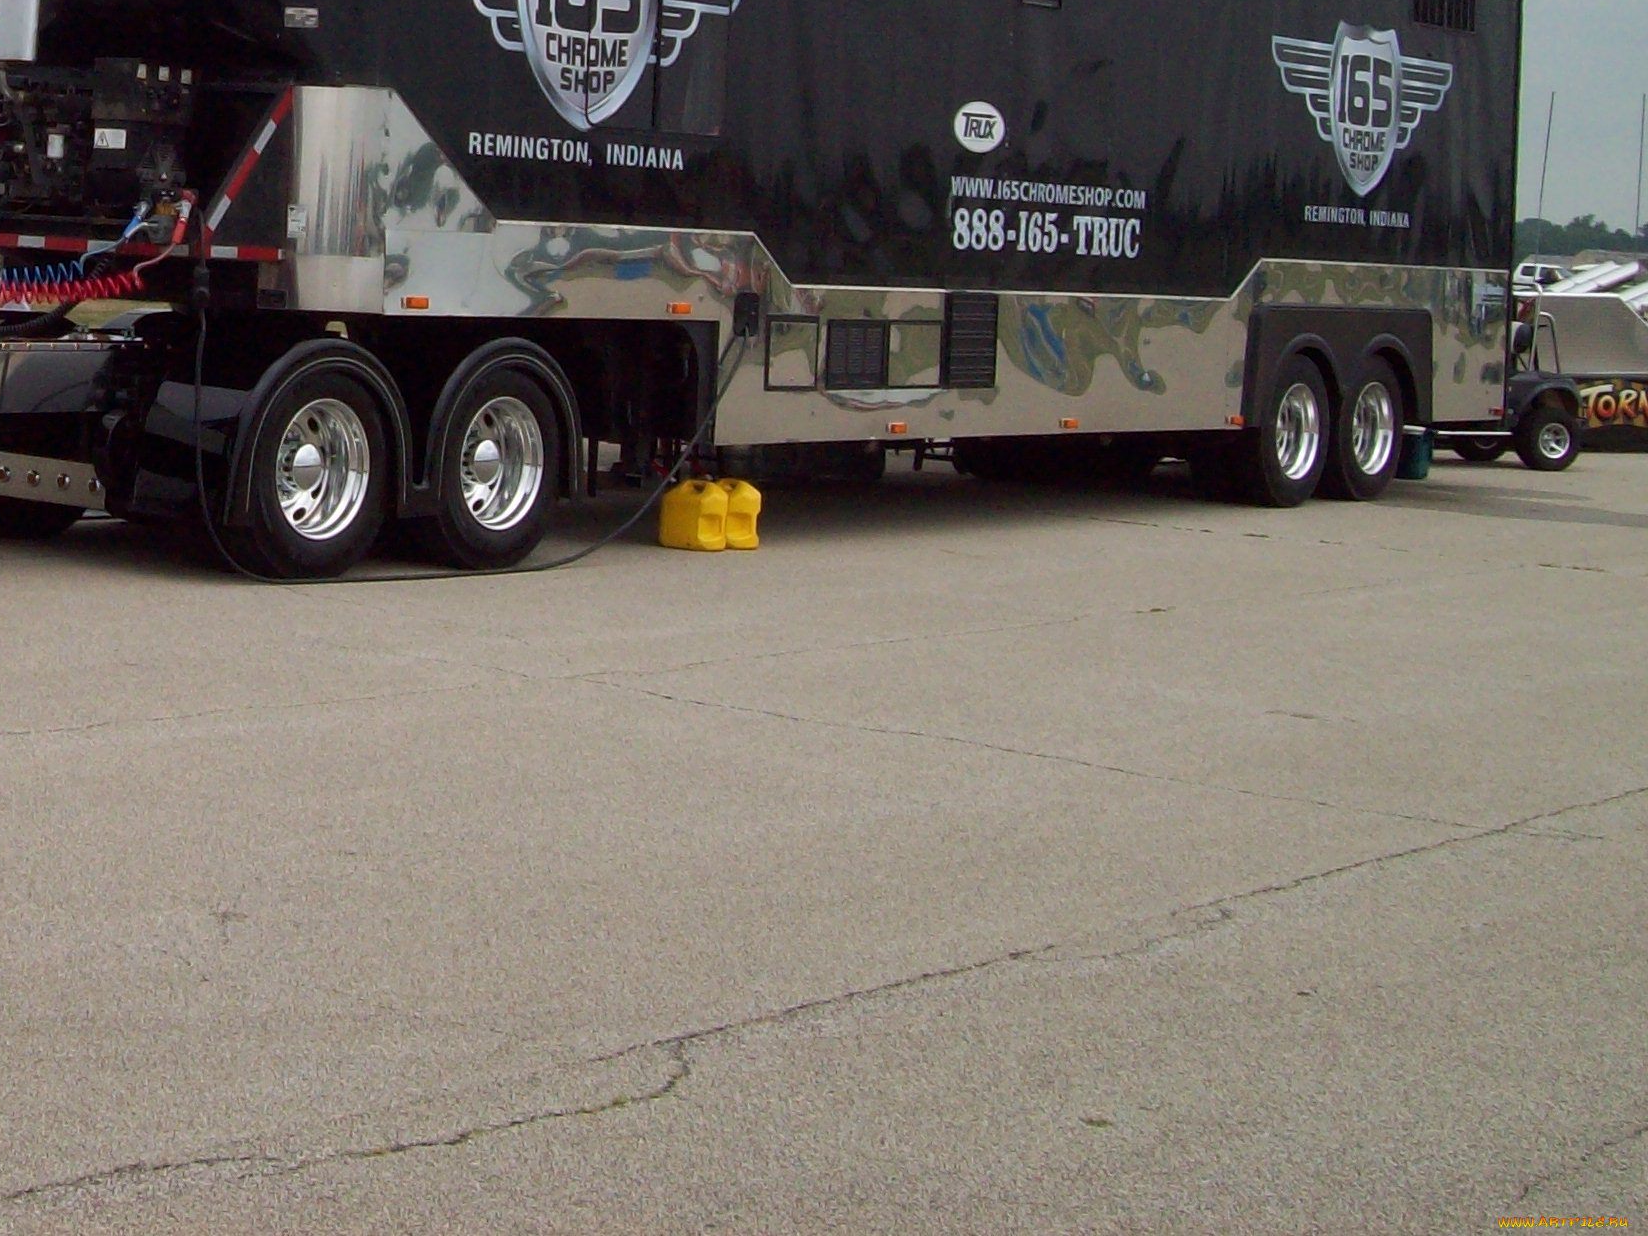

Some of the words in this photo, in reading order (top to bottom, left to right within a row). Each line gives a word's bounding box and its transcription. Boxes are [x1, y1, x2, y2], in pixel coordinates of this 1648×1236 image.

[546, 32, 629, 68] CHROME
[560, 66, 616, 94] SHOP
[962, 112, 997, 140] TRUX
[1342, 127, 1387, 153] CHROME
[468, 132, 593, 166] REMINGTON,
[606, 143, 684, 171] INDIANA
[1349, 152, 1379, 172] SHOP
[1304, 205, 1366, 227] REMINGTON,
[1370, 210, 1410, 228] INDIANA
